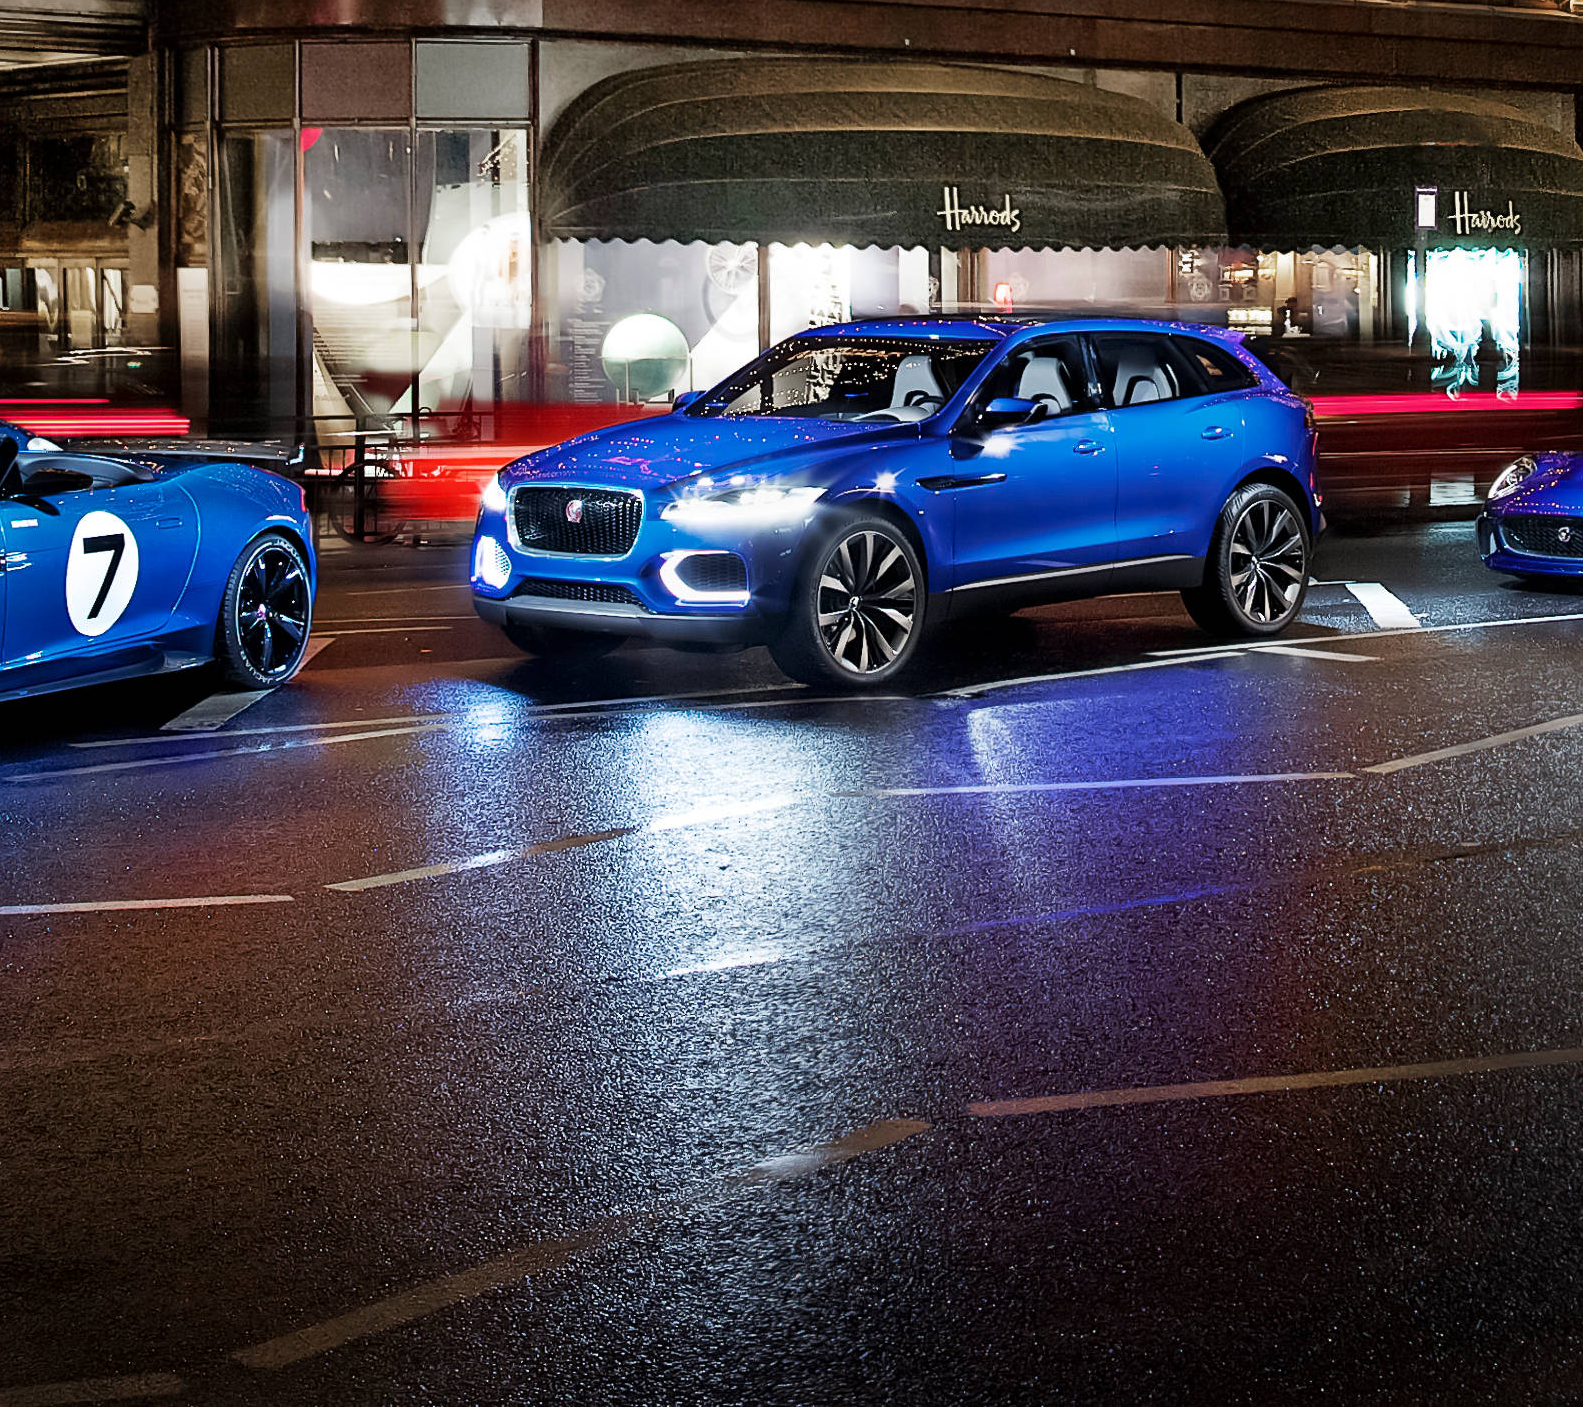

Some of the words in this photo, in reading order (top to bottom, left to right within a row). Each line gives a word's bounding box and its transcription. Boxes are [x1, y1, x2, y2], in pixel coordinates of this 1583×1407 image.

[937, 187, 1020, 232] Harrods
[1446, 191, 1521, 235] Harrods
[83, 533, 125, 620] 7
